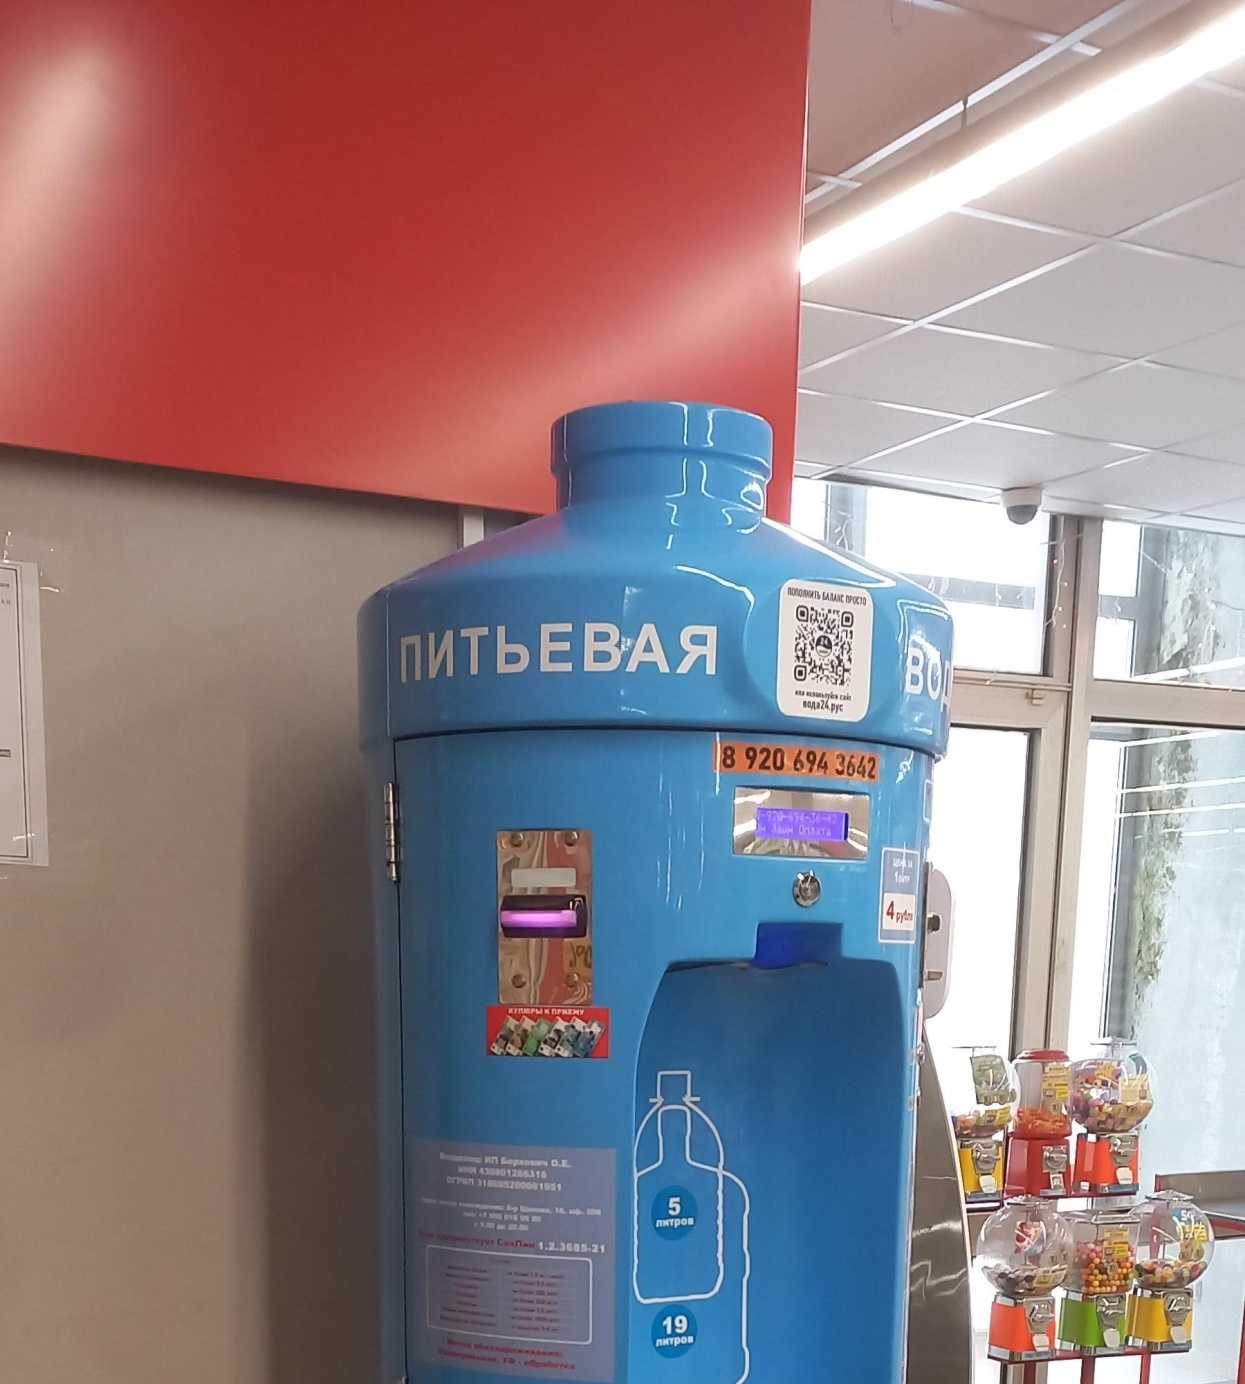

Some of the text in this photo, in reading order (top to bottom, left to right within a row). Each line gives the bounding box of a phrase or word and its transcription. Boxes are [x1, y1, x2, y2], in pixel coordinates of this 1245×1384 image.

[822, 591, 844, 603] БАЛАНС
[845, 595, 867, 606] ПРОСТО
[400, 622, 718, 684] ПИТЬЕВАЯ
[722, 746, 876, 779] 8 920 694 3642
[886, 900, 895, 920] 4
[668, 1197, 681, 1215] 5
[656, 1217, 694, 1228] литров
[662, 1315, 688, 1334] 19
[656, 1337, 694, 1347] литров
